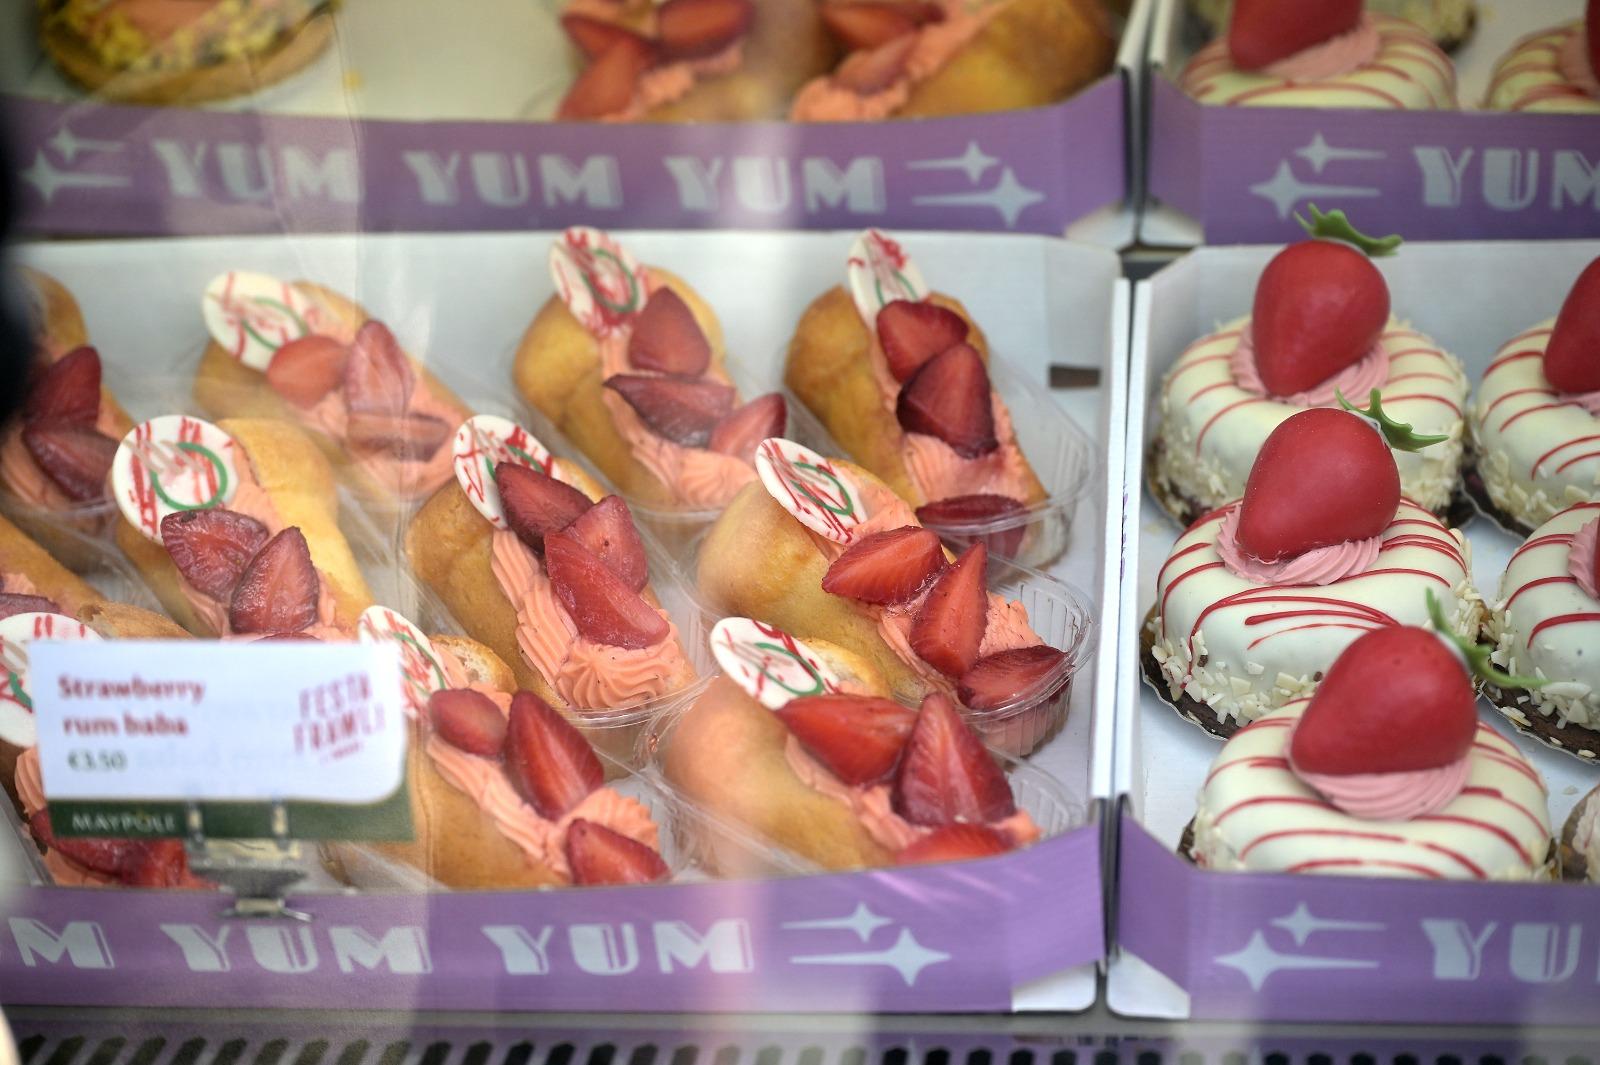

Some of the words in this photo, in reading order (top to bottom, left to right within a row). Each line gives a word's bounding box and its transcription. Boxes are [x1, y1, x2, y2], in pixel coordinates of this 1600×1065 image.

[152, 140, 364, 203] YUM
[404, 150, 623, 209] YUM
[662, 156, 887, 214] YUM
[57, 674, 205, 705] Strawberry
[63, 717, 119, 736] rum
[122, 710, 189, 736] baba
[71, 812, 176, 833] MAYPOLE
[160, 923, 433, 974] YUM
[481, 918, 754, 976] YUM
[1420, 918, 1600, 983] YU
